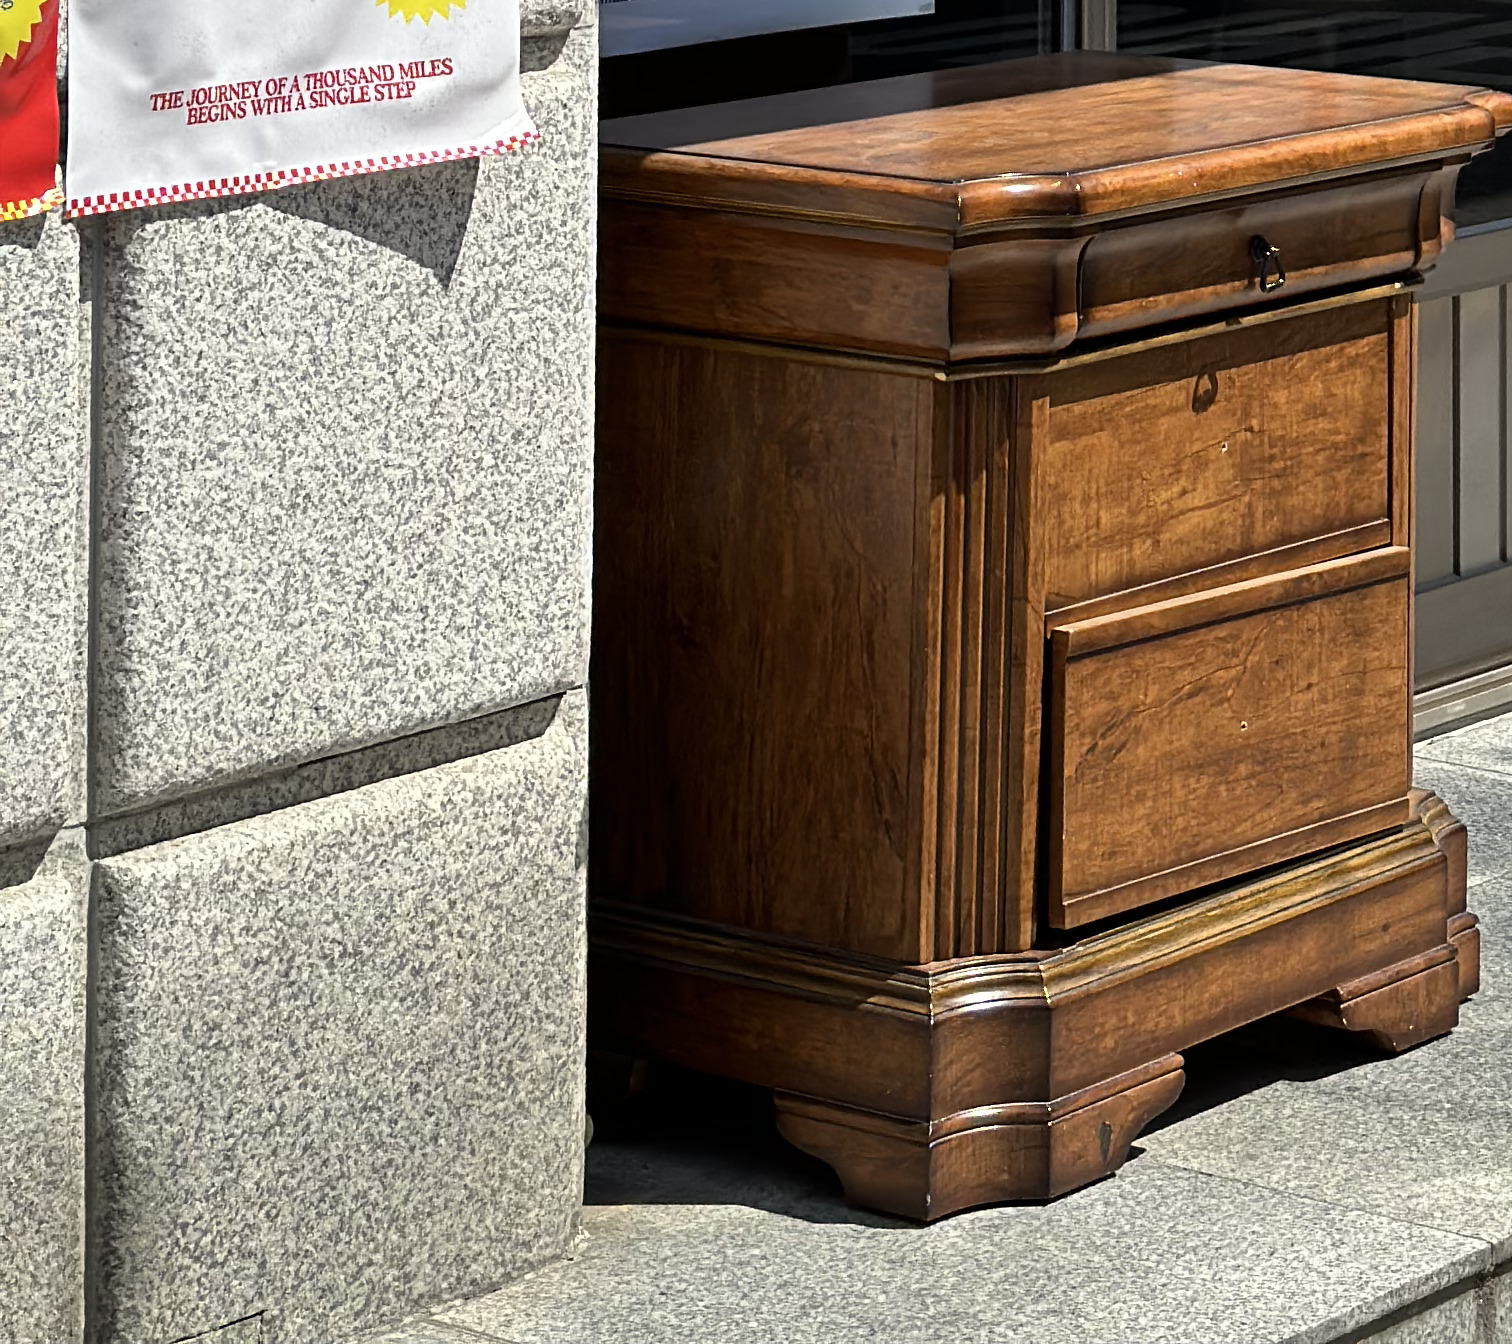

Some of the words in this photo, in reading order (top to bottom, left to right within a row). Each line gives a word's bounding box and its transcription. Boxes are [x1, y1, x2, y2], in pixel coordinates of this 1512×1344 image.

[150, 91, 185, 112] THE
[186, 80, 262, 108] JOURNEY
[265, 76, 288, 97] OF
[288, 75, 301, 94] A
[303, 64, 395, 92] THOUSAND
[399, 57, 454, 80] MILES
[186, 100, 247, 126] BEGINS
[251, 95, 293, 117] WITH
[294, 93, 306, 112] A
[309, 85, 371, 109] SINGLE
[374, 81, 416, 102] STEP
